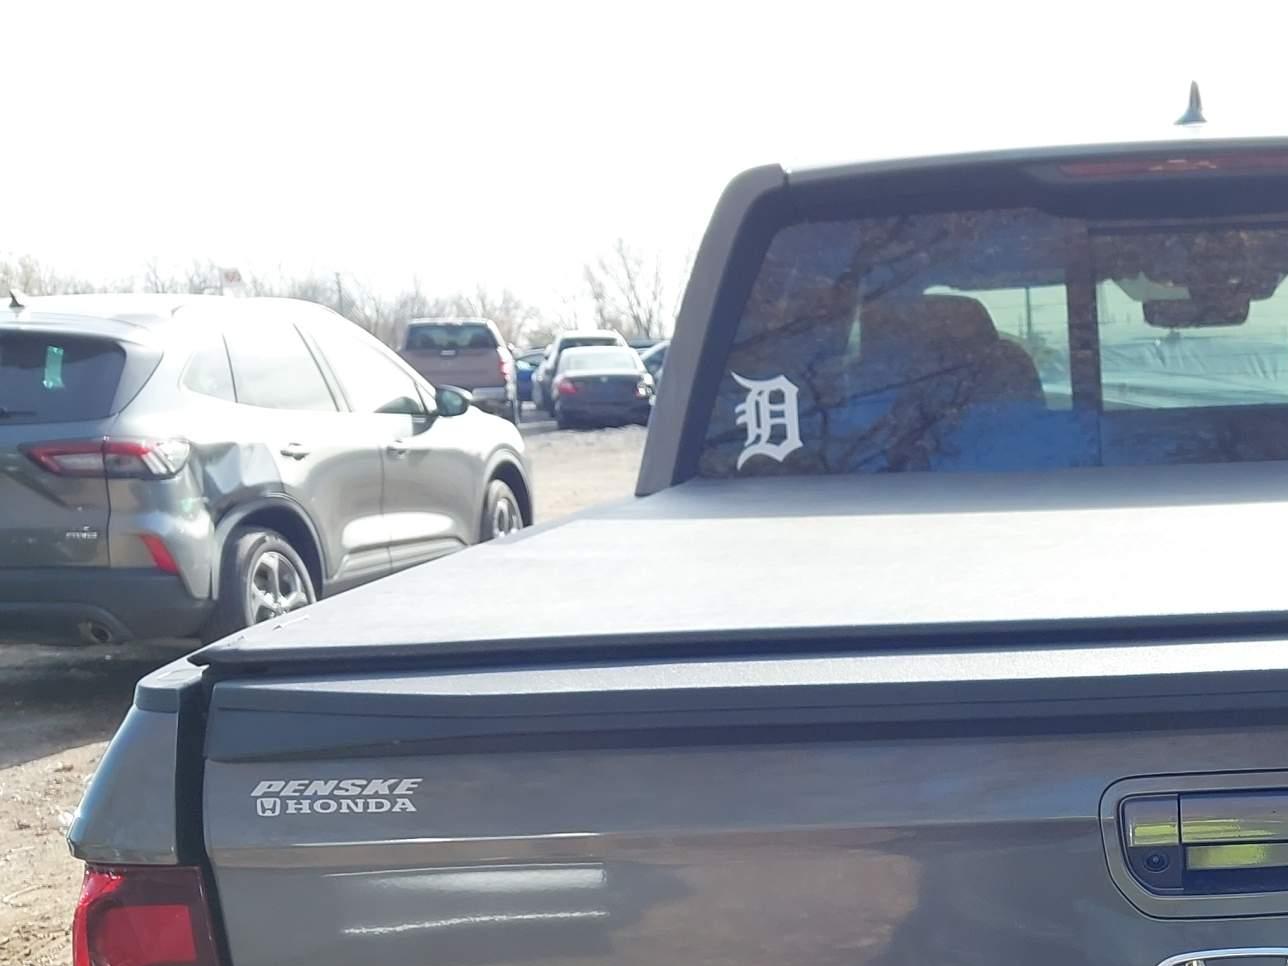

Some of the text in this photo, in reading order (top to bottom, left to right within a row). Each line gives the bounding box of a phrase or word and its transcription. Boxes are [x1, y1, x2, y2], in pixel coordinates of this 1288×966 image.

[729, 369, 804, 471] D
[250, 778, 423, 797] PENSKE
[285, 797, 417, 814] HONDA
